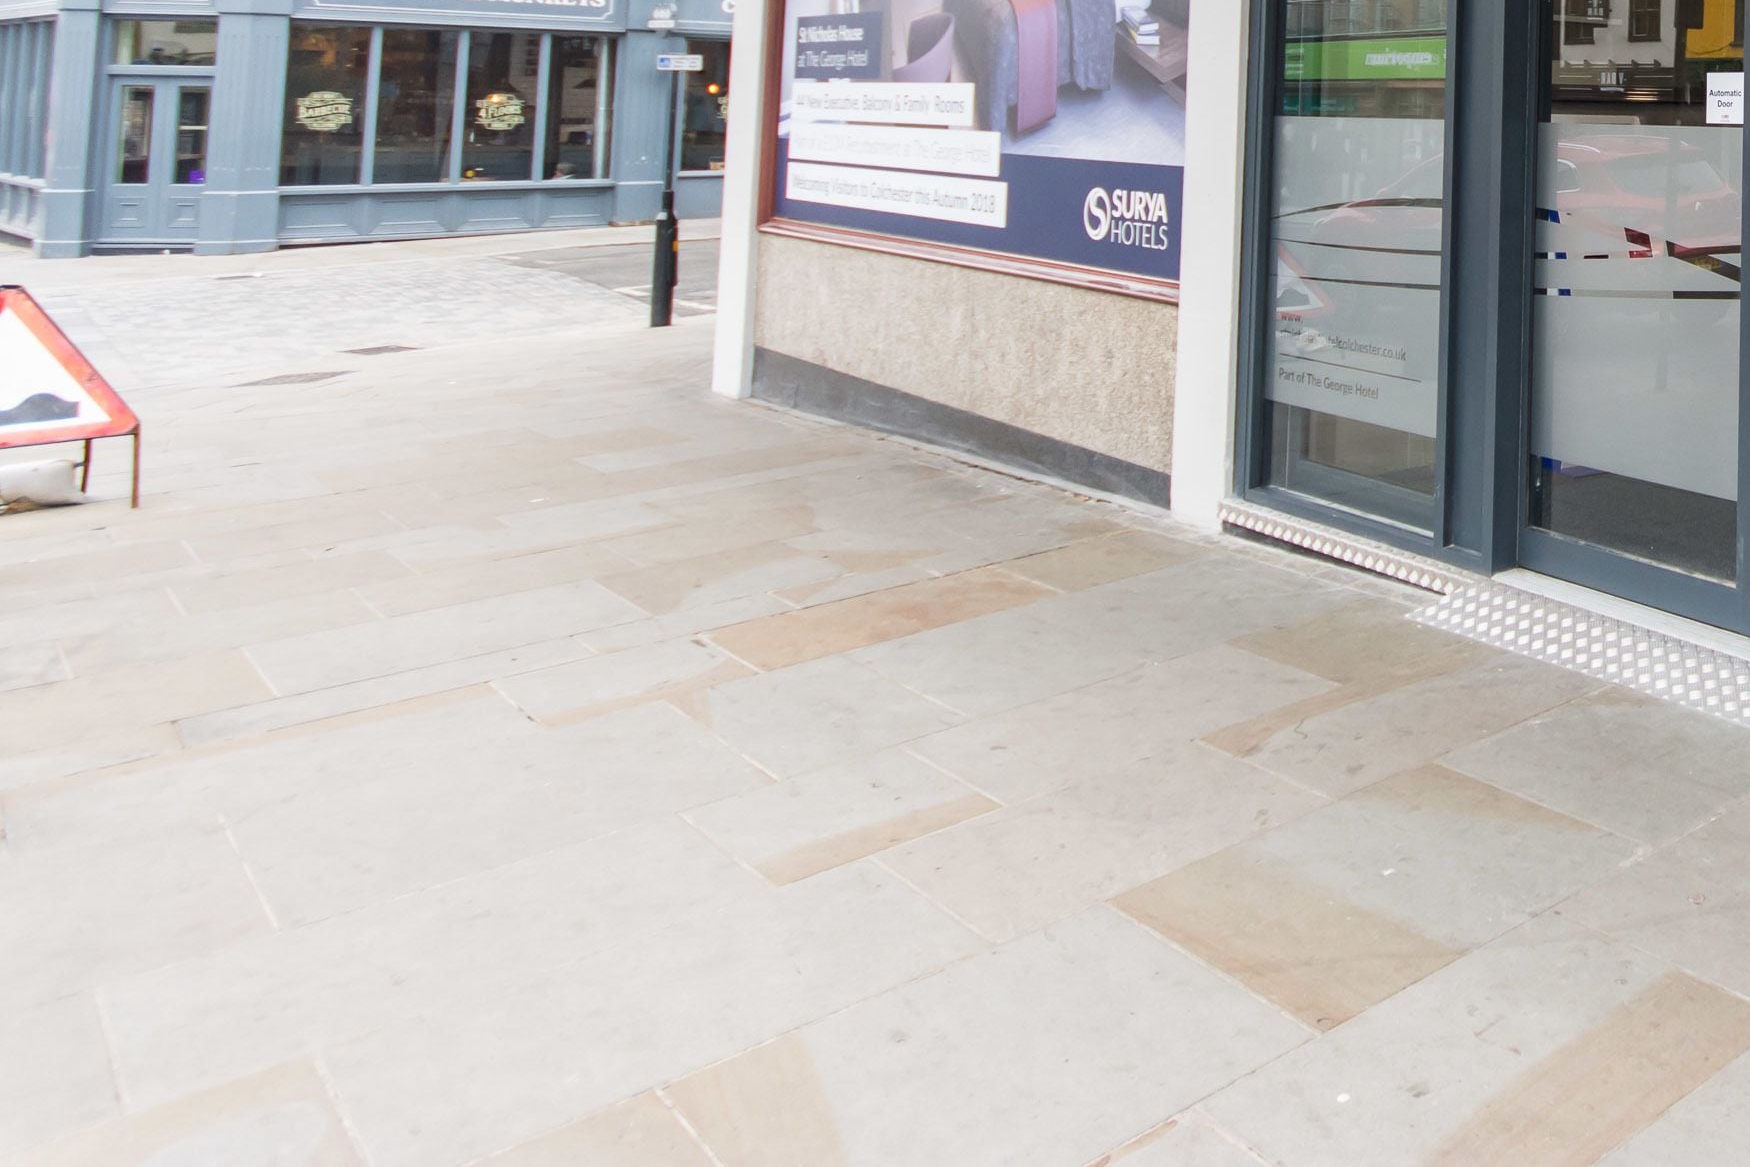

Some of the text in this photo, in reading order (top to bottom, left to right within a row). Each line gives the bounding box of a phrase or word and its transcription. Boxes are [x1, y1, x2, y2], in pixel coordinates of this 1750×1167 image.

[1709, 89, 1742, 98] Automatic
[1717, 99, 1733, 108] Door
[1111, 188, 1168, 223] SURYA
[1110, 219, 1168, 250] HOTELS
[1278, 367, 1379, 400] Part of The George Hotel
